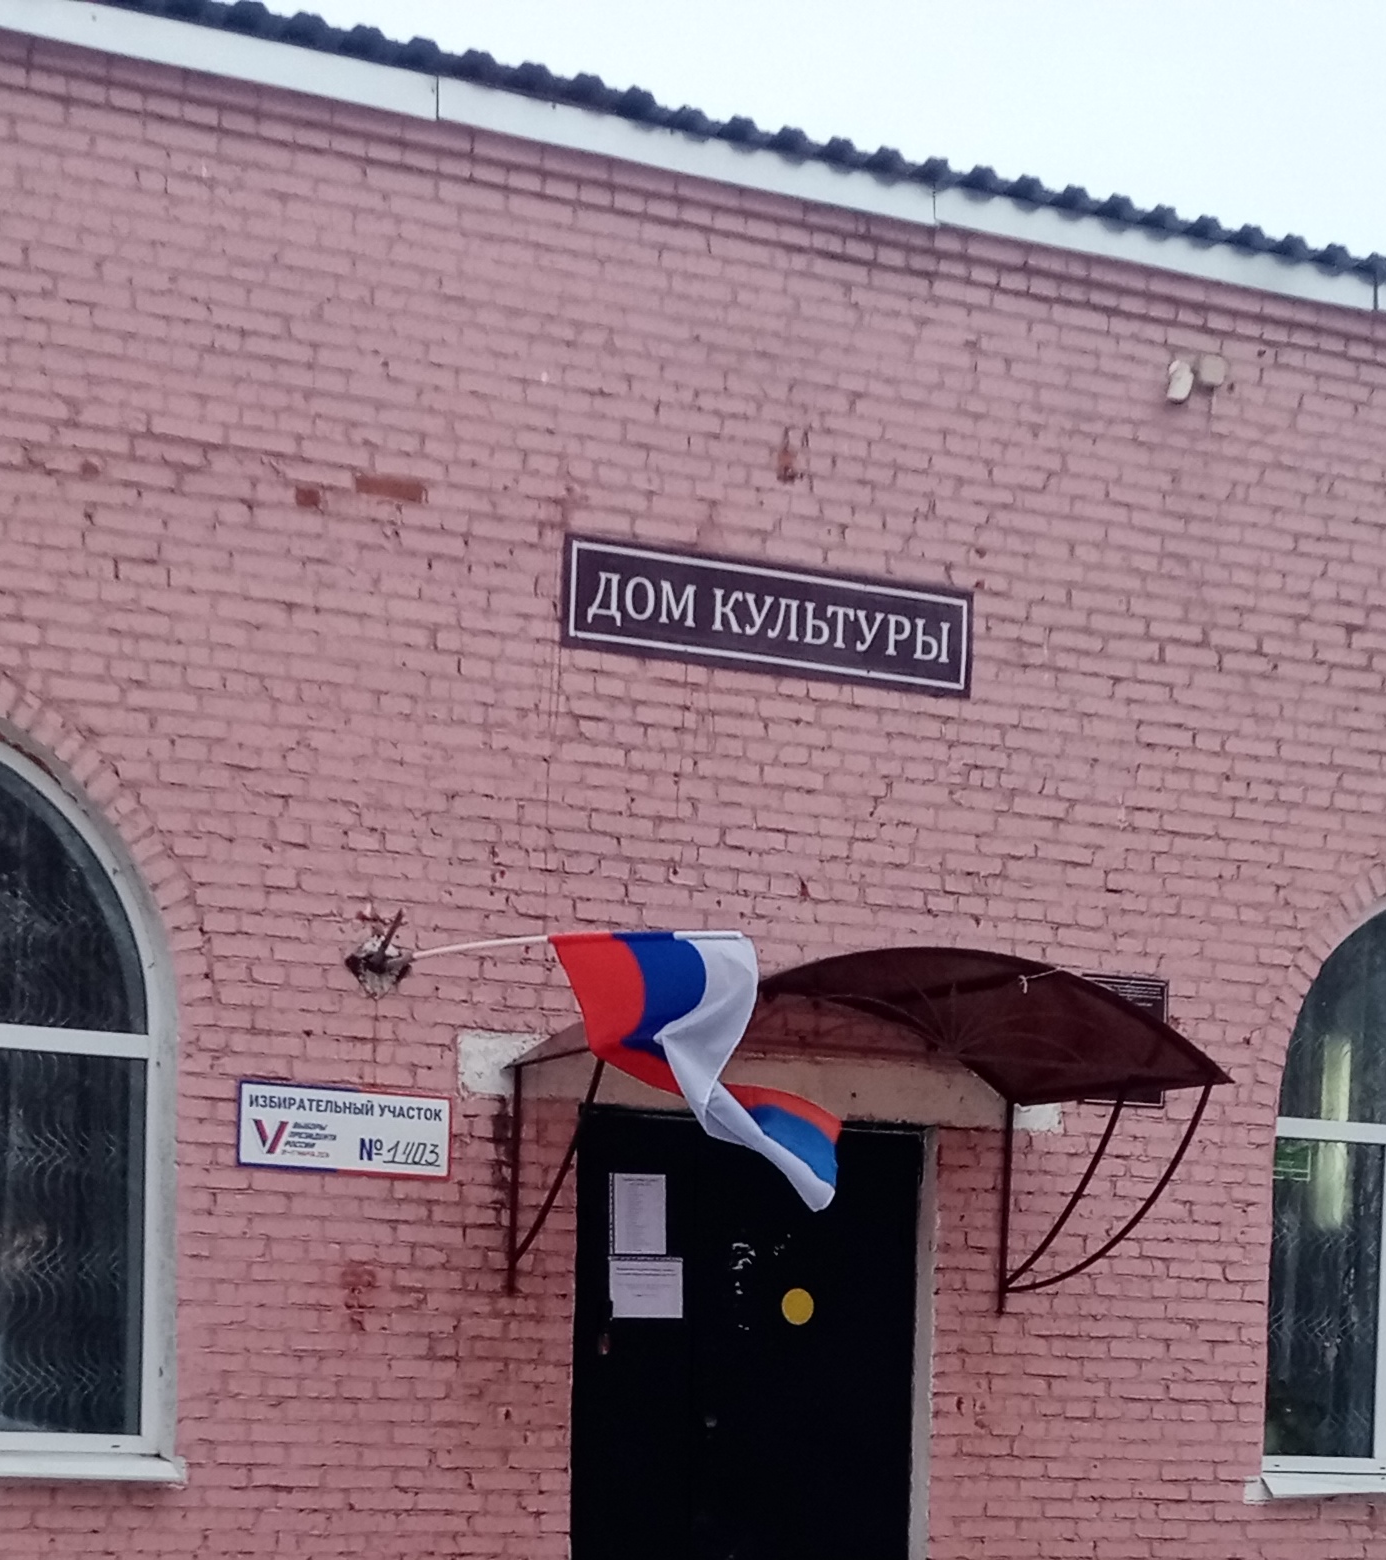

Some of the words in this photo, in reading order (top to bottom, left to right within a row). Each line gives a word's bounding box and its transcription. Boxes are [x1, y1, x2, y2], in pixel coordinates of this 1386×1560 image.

[587, 571, 697, 628] ДОМ
[711, 588, 952, 664] КУЛЬТУРЫ
[248, 1093, 375, 1117] ИЗБИРАТЕЛЬНЫЙ
[379, 1103, 443, 1122] УЧАСТОК
